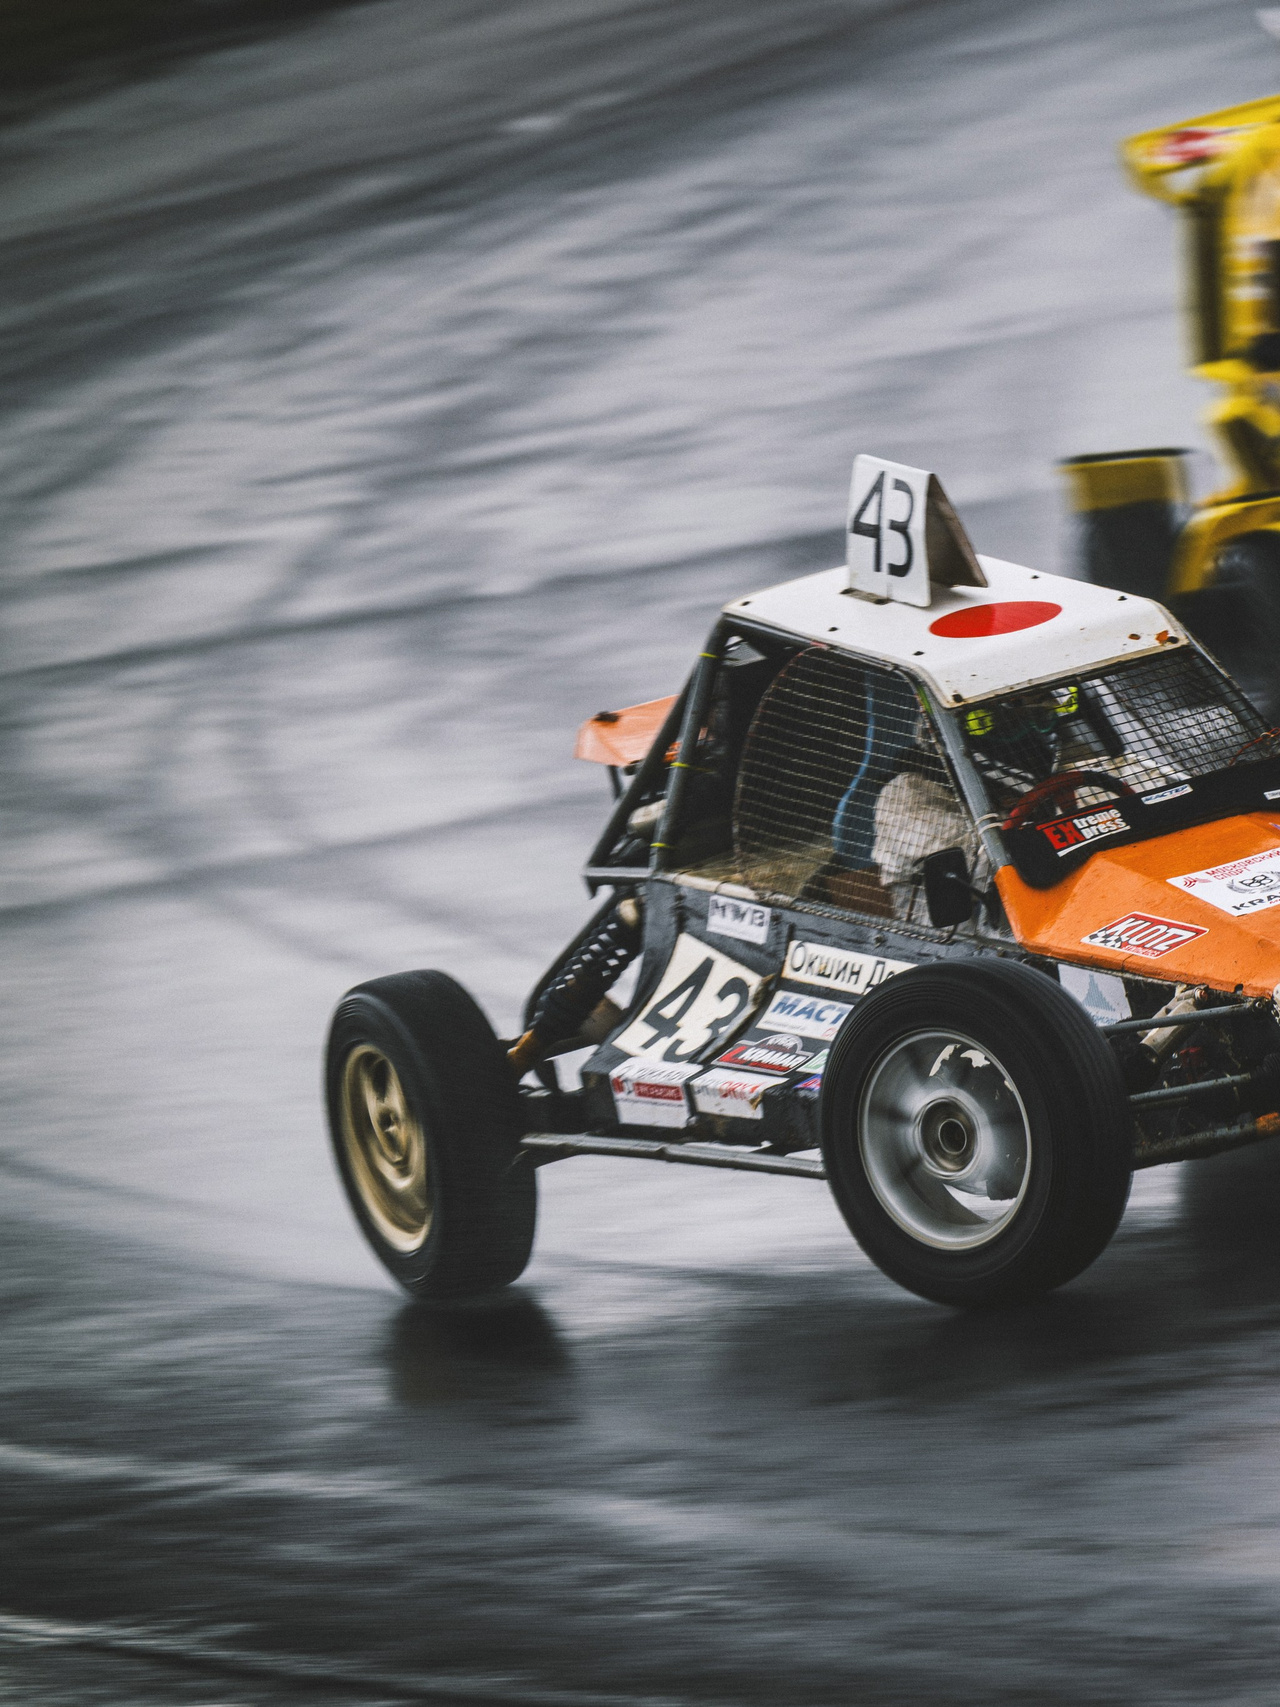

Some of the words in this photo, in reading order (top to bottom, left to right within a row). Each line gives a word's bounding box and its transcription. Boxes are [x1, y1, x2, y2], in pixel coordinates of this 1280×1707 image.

[850, 471, 914, 577] 43
[1213, 867, 1251, 881] СПОРТ
[1098, 917, 1197, 951] KLOTZ
[790, 941, 864, 985] Окшин
[641, 957, 750, 1062] 43
